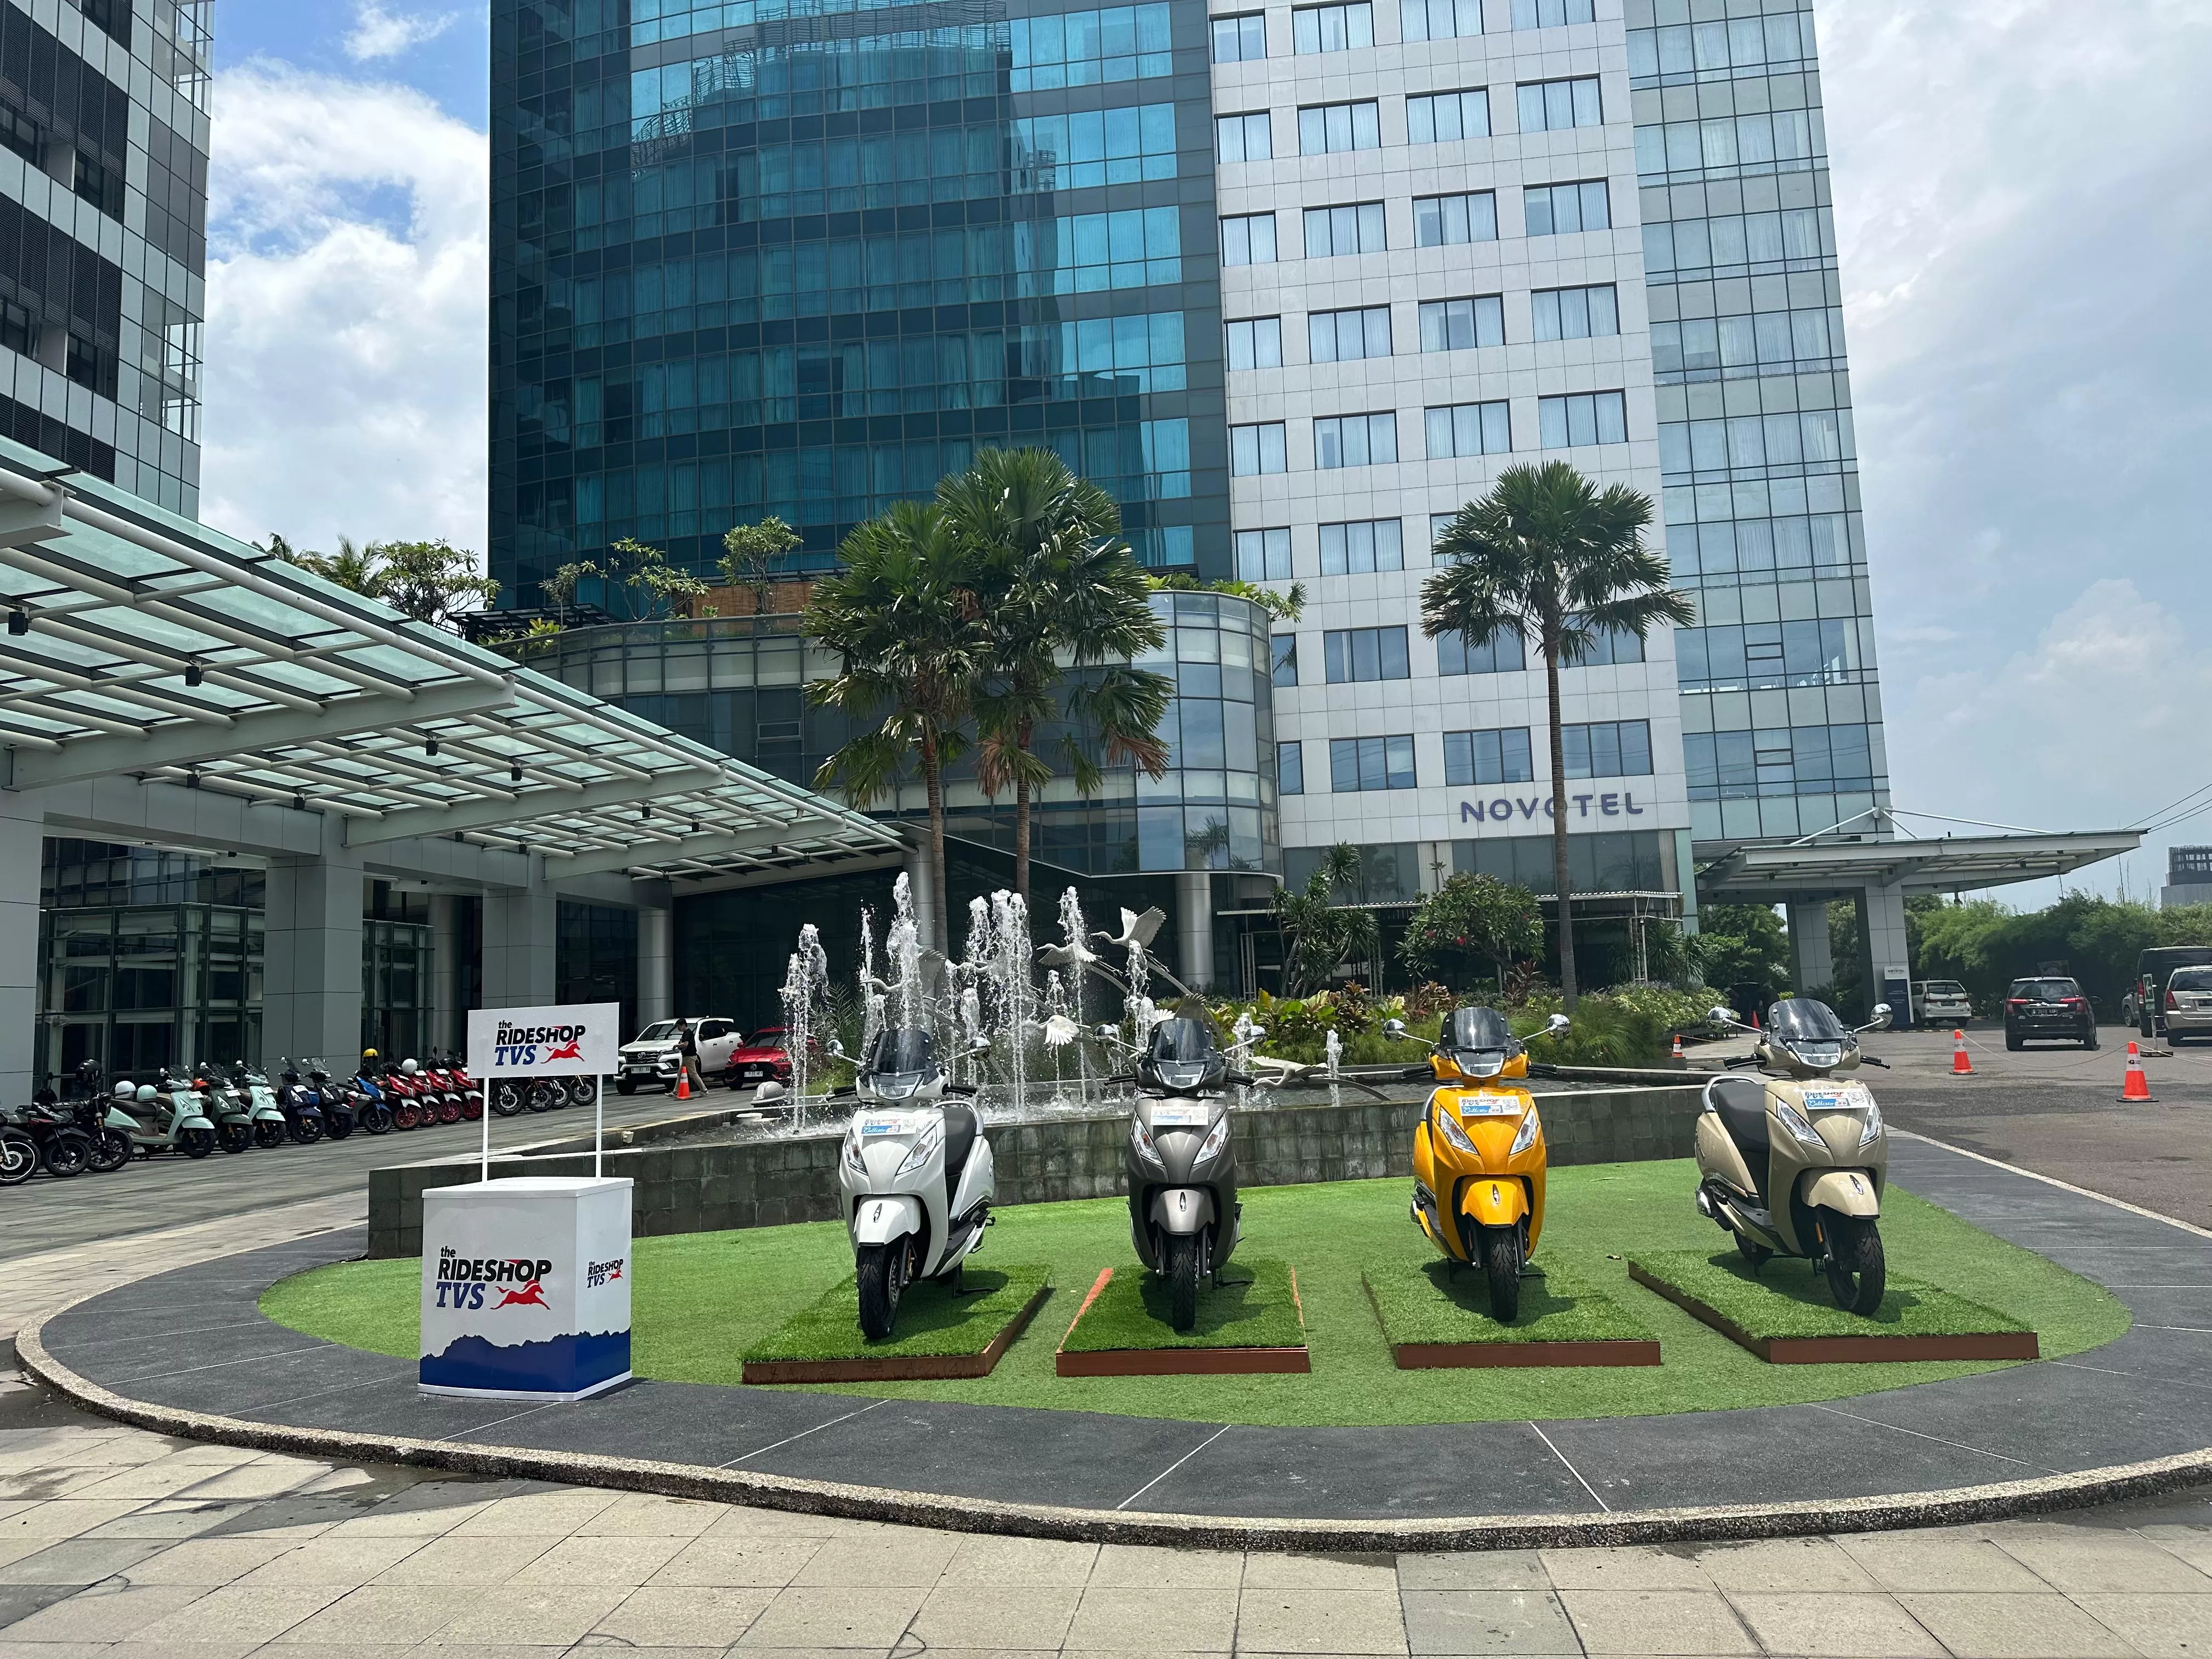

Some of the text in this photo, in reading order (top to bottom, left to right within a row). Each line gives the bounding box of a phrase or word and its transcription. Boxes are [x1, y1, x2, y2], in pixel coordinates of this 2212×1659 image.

[498, 1020, 512, 1029] the
[496, 1025, 586, 1046] RIDESHOP
[495, 1045, 537, 1066] TVS
[441, 1245, 456, 1257] the
[438, 1258, 552, 1283] RIDESHOP
[588, 1259, 624, 1276] RIDESHOP
[587, 1273, 605, 1288] TVS
[436, 1281, 487, 1310] TVS
